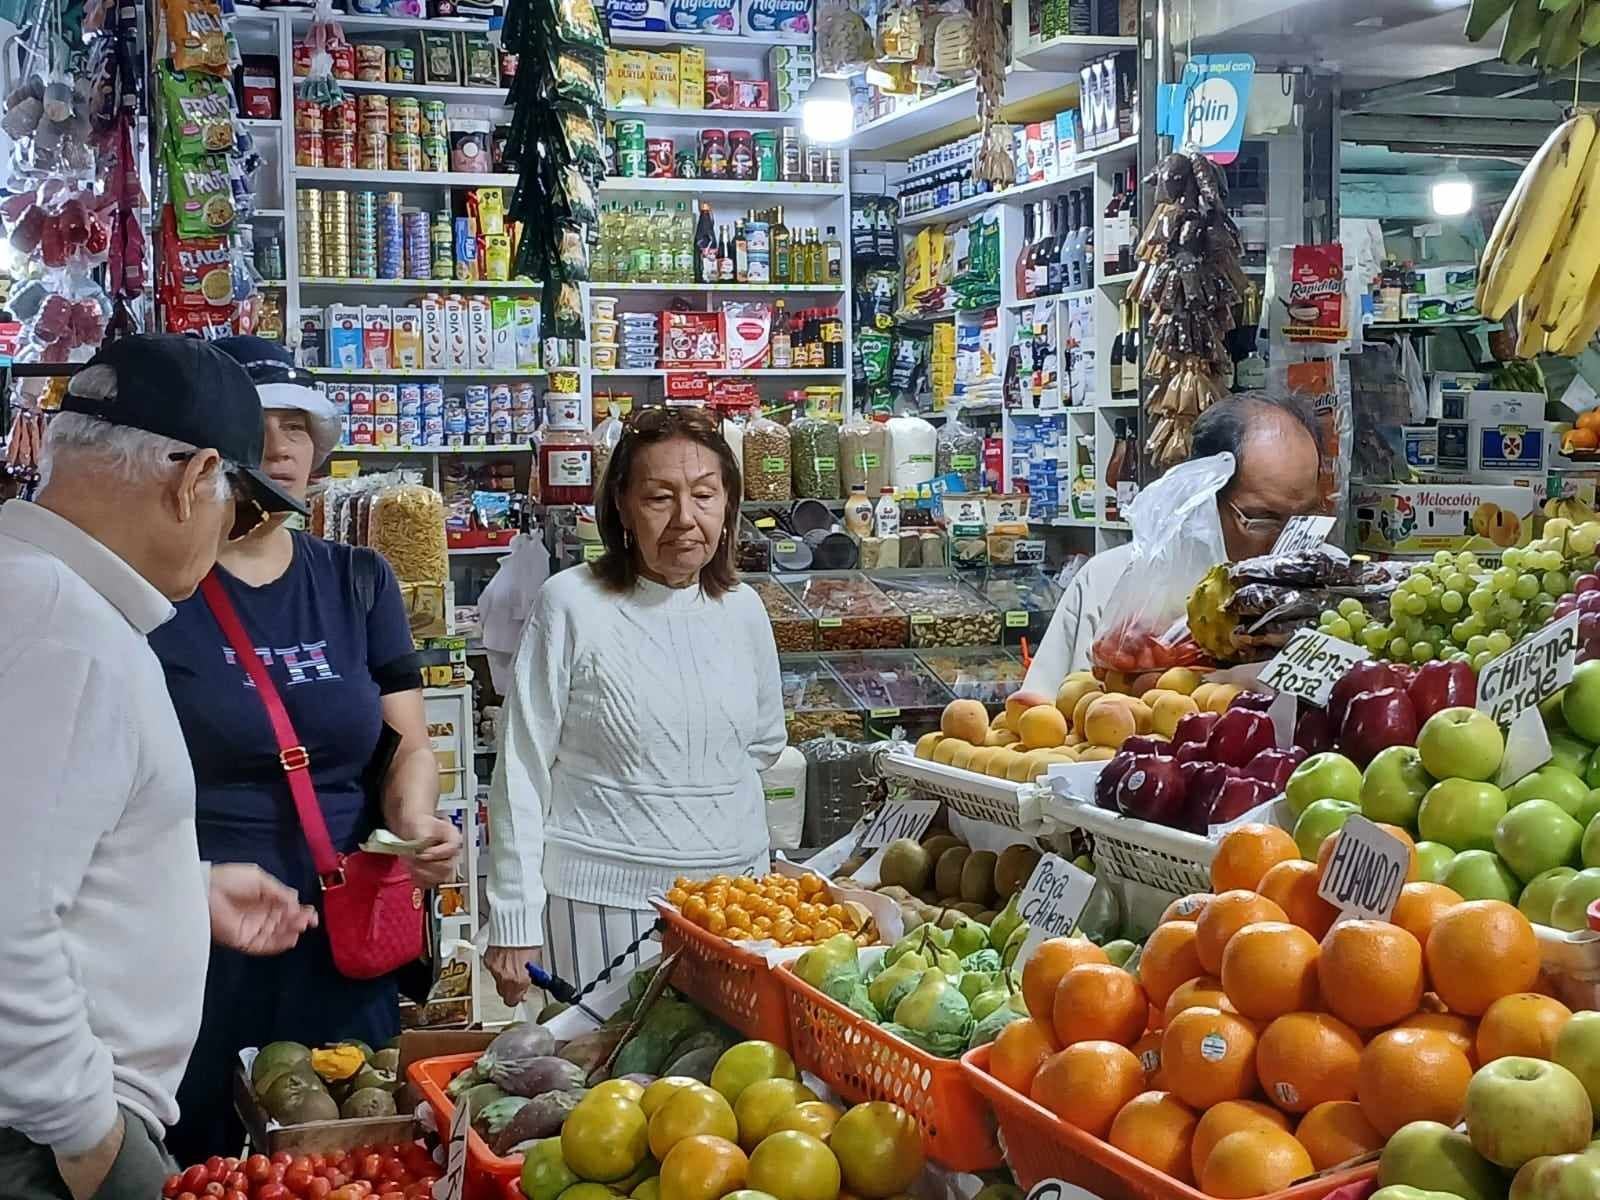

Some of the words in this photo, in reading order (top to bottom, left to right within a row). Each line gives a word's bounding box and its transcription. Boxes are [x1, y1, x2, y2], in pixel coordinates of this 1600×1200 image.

[1191, 97, 1229, 128] plin
[868, 802, 931, 844] KIWI
[1322, 831, 1400, 915] HUANDO
